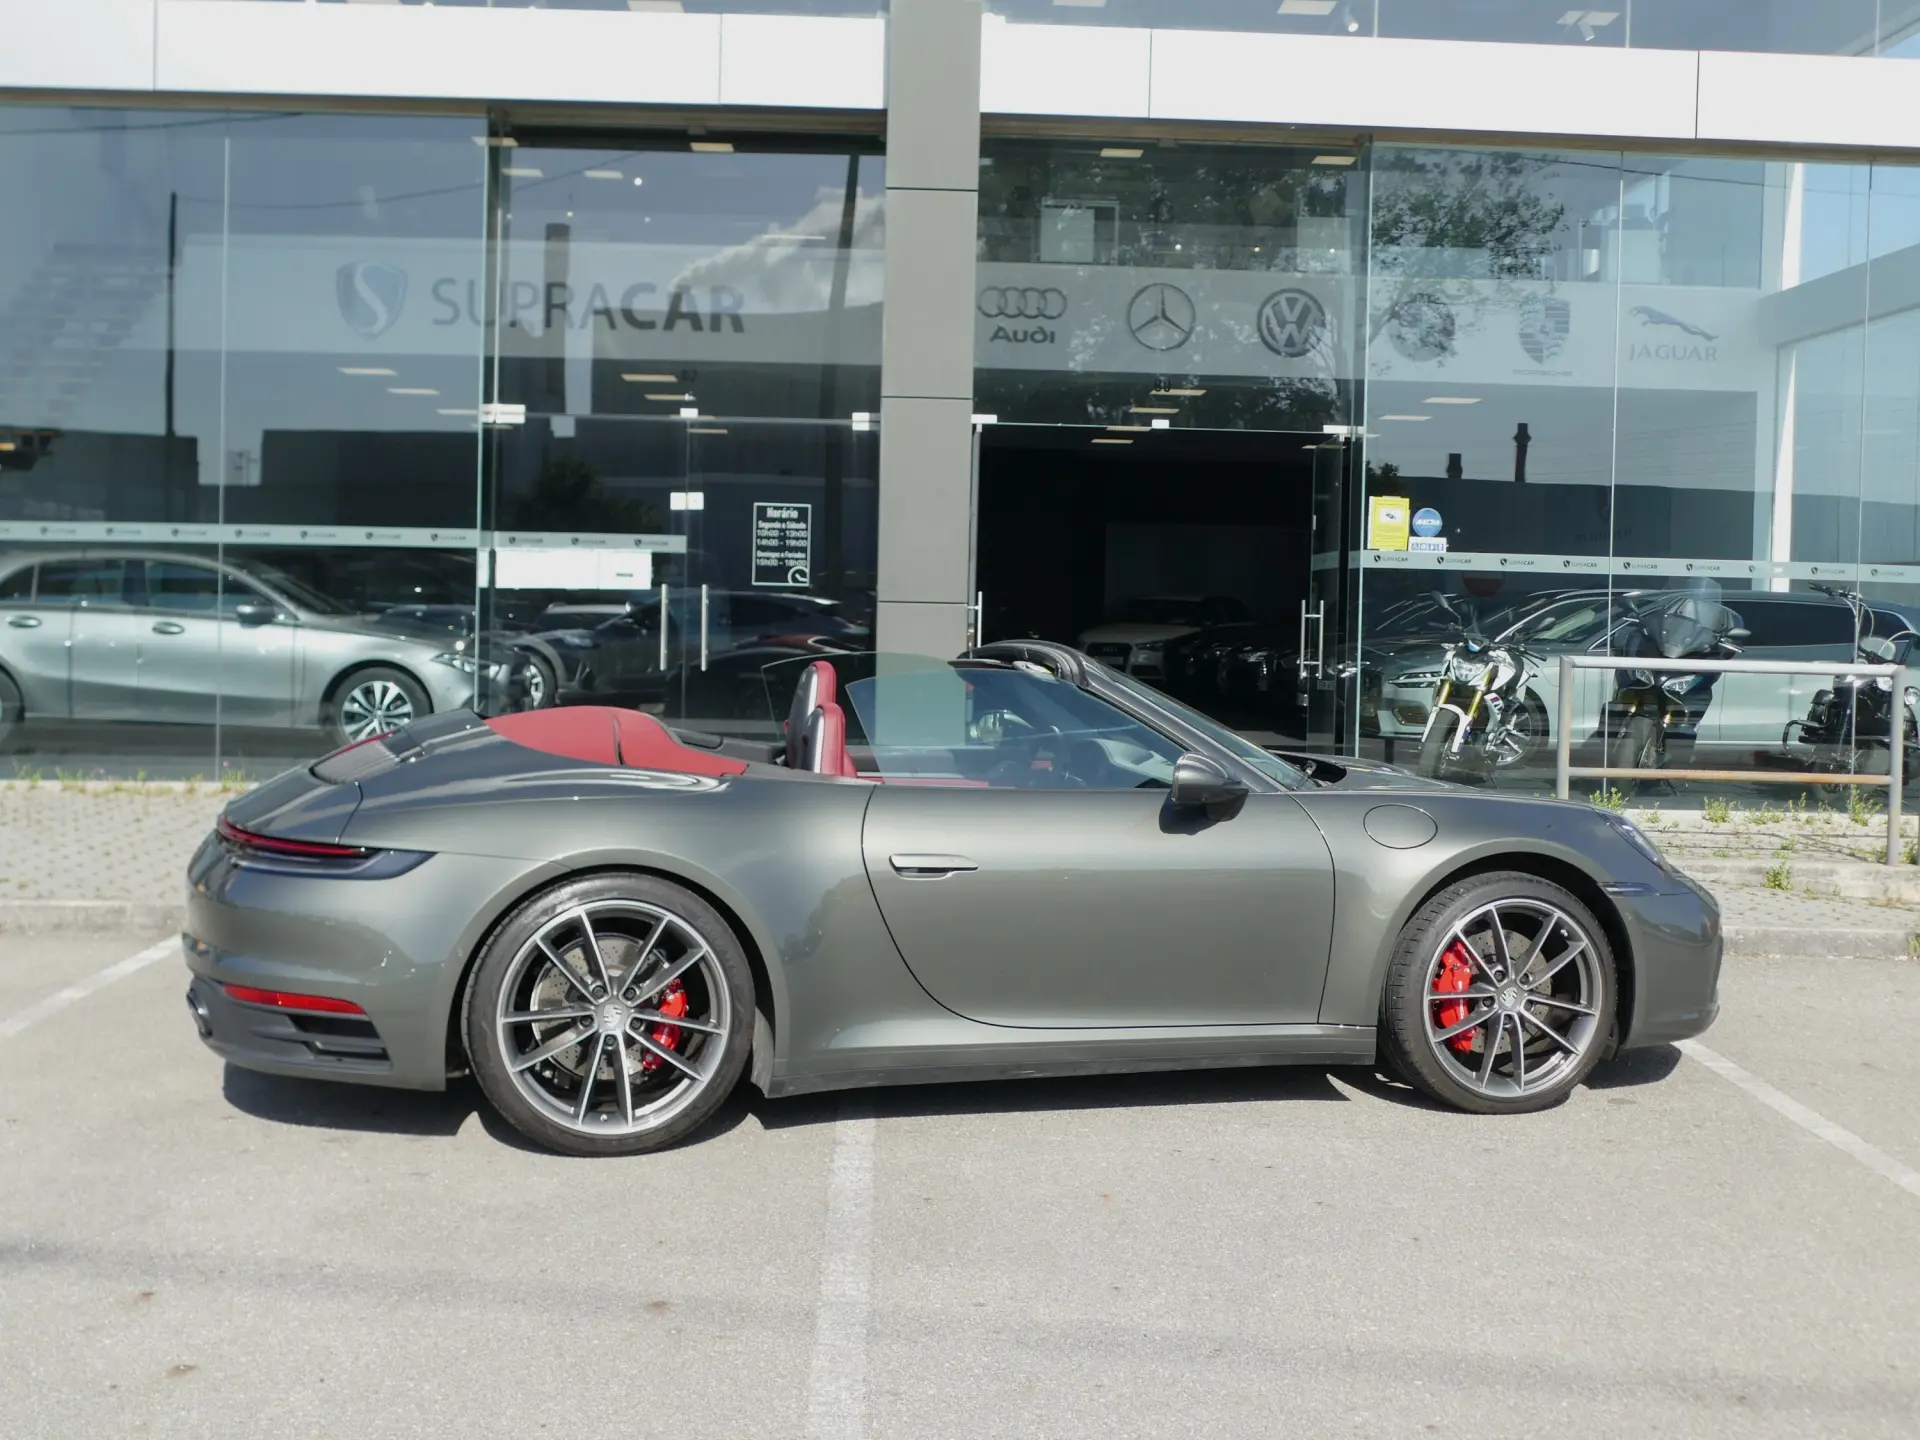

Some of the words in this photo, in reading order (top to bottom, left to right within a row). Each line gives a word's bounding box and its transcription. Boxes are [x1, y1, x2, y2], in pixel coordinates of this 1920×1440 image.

[431, 277, 746, 333] SUPRACAR
[989, 326, 1056, 344] Audi
[1629, 343, 1718, 363] JAGUAR
[766, 507, 799, 519] Horário
